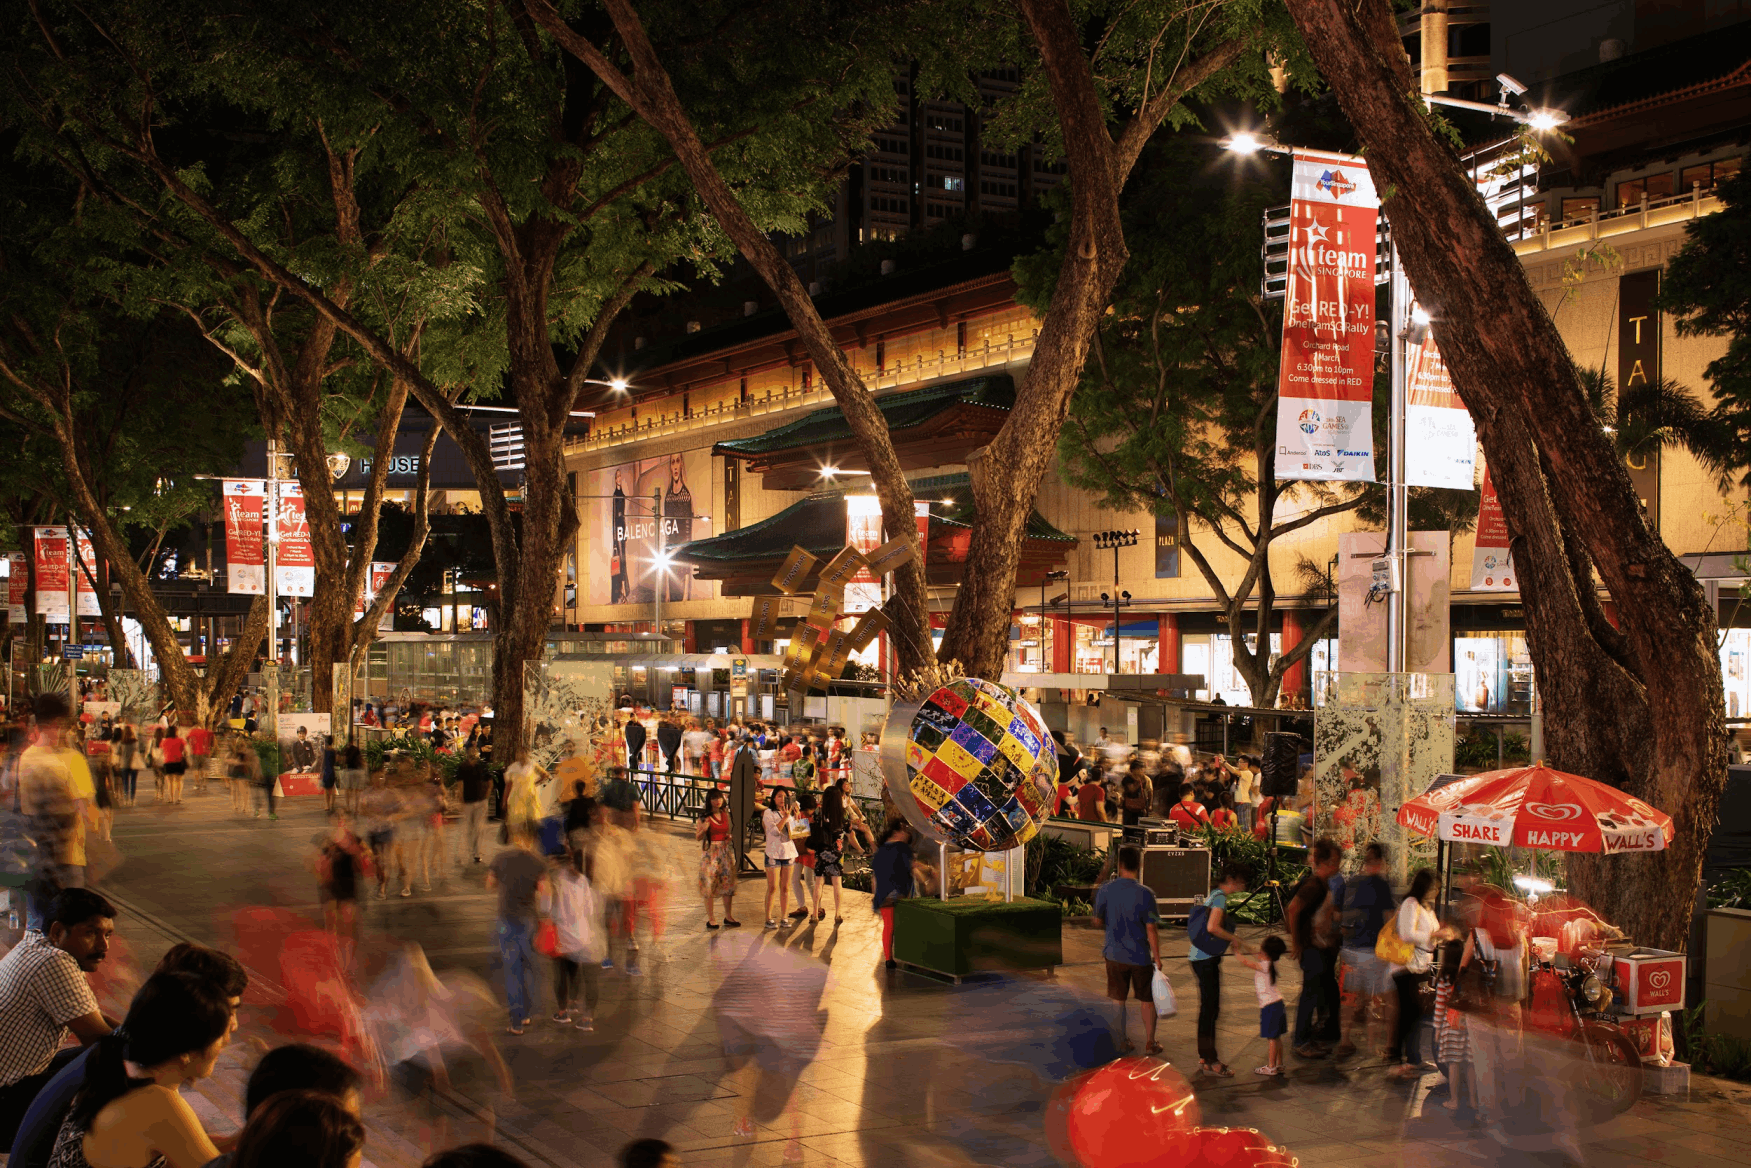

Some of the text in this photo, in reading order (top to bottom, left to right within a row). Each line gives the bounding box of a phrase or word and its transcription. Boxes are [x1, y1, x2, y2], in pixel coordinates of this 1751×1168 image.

[1317, 244, 1367, 269] team
[1317, 266, 1366, 279] SINGAPORE
[1319, 300, 1369, 319] RED-Y!
[1344, 322, 1369, 336] Rally
[1303, 340, 1350, 352] Orchard Road
[1318, 352, 1340, 362] March
[1297, 362, 1354, 376] 6.30pm to 10pm
[1288, 373, 1362, 386] Come dressed in RED
[1322, 422, 1343, 430] GAMES
[1335, 415, 1346, 423] SEA
[361, 456, 419, 474] HUSE
[1309, 463, 1323, 471] DBS
[727, 466, 735, 528] TAN
[237, 510, 260, 519] team
[617, 519, 680, 542] BALENCAGA
[1158, 535, 1175, 546] PLAZA
[782, 554, 807, 588] MYANMAR
[830, 553, 860, 583] MALAYSIA
[821, 594, 831, 615] LAOS
[756, 600, 770, 636] THAILAND
[855, 618, 877, 643] BRUNEI
[828, 636, 845, 669] VIETNAM
[1406, 808, 1434, 836] WALL'S
[1453, 823, 1655, 851] SHARE HAPPY WALL'S
[1649, 988, 1670, 998] WALL'S
